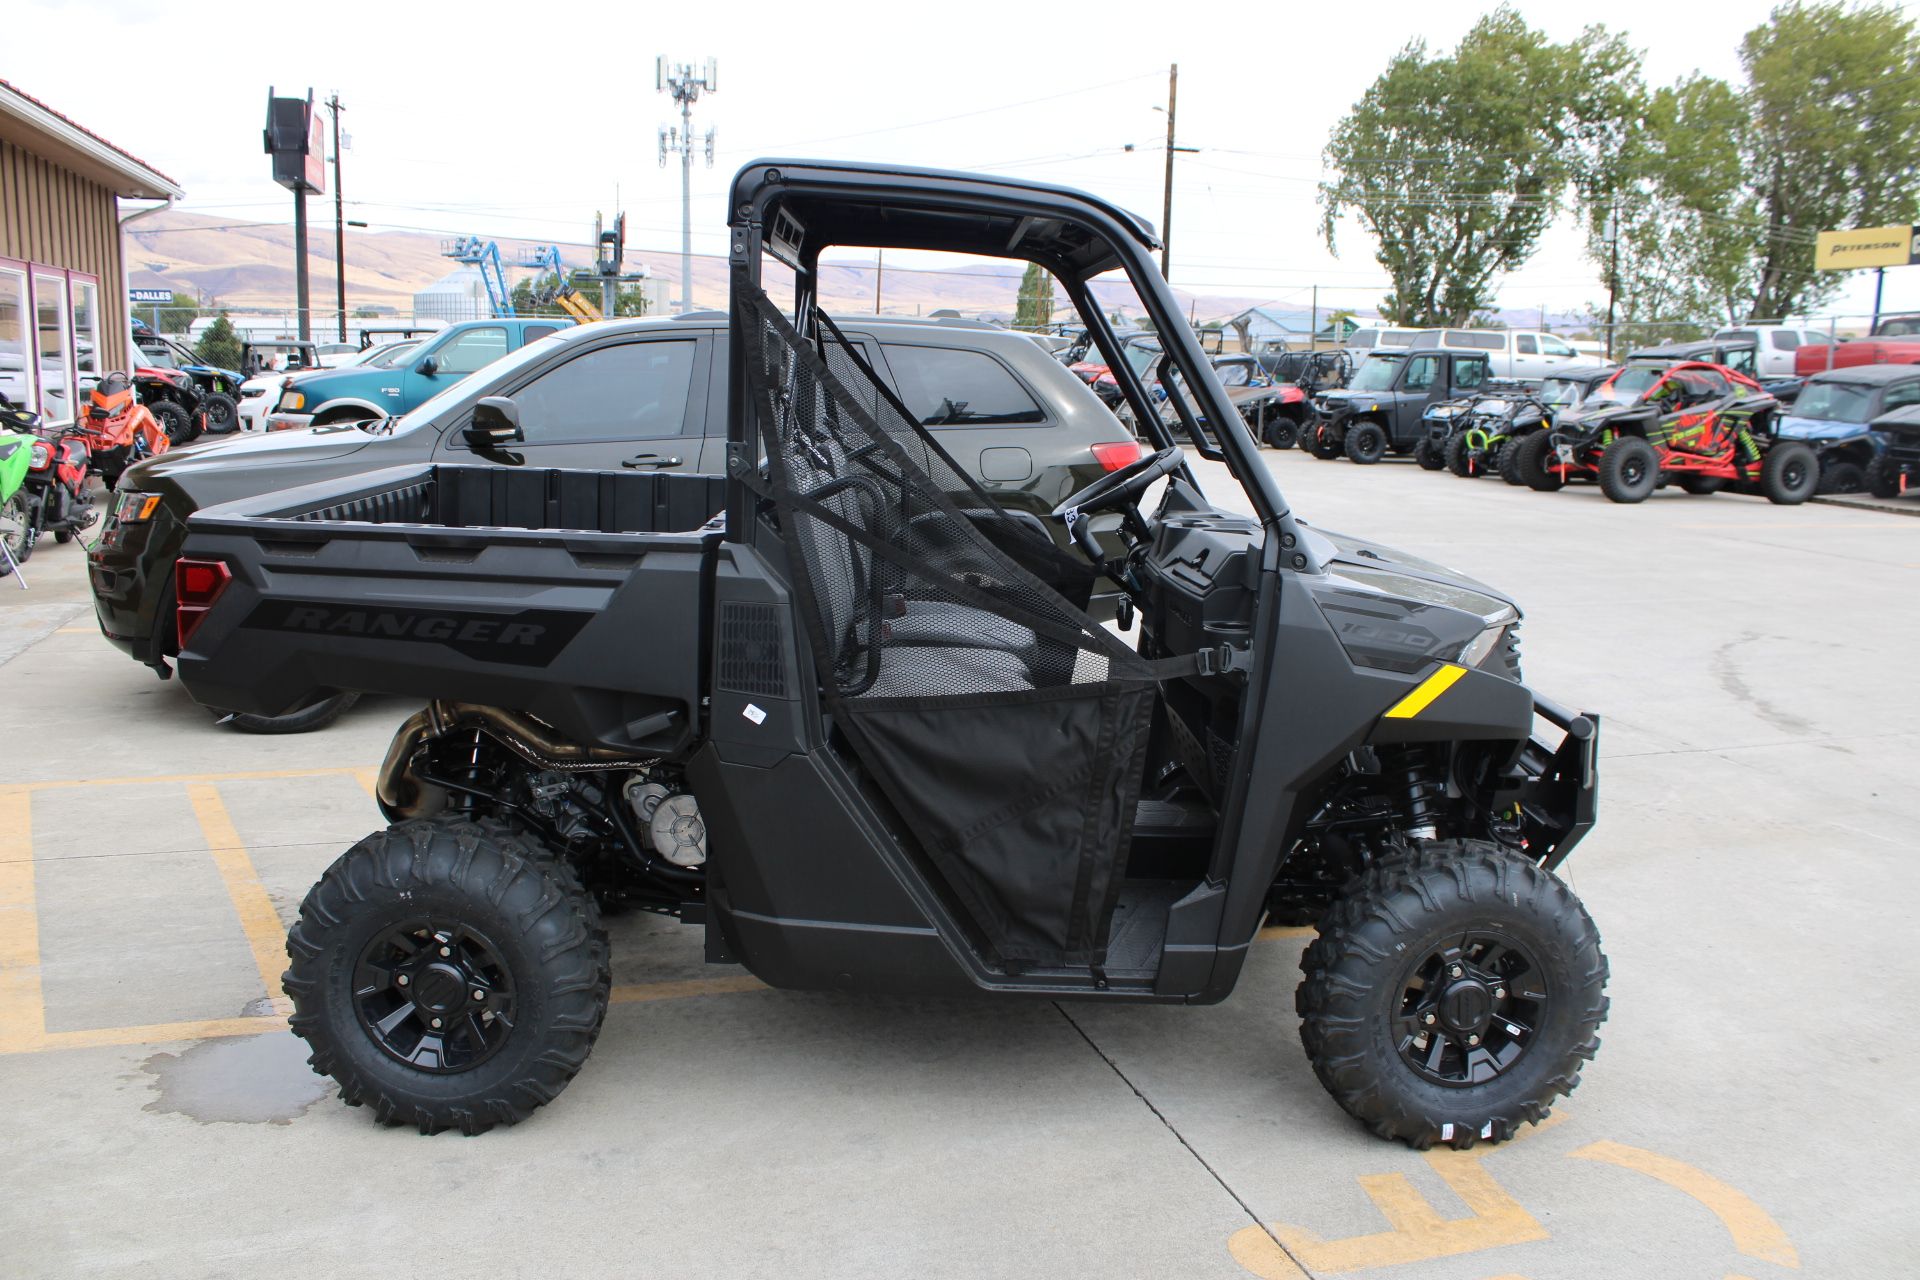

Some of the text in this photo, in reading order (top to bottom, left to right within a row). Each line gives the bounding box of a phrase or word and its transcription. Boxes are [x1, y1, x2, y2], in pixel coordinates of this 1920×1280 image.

[1830, 242, 1902, 256] PETERSON
[136, 291, 171, 300] DALLES
[282, 606, 547, 646] RANGER
